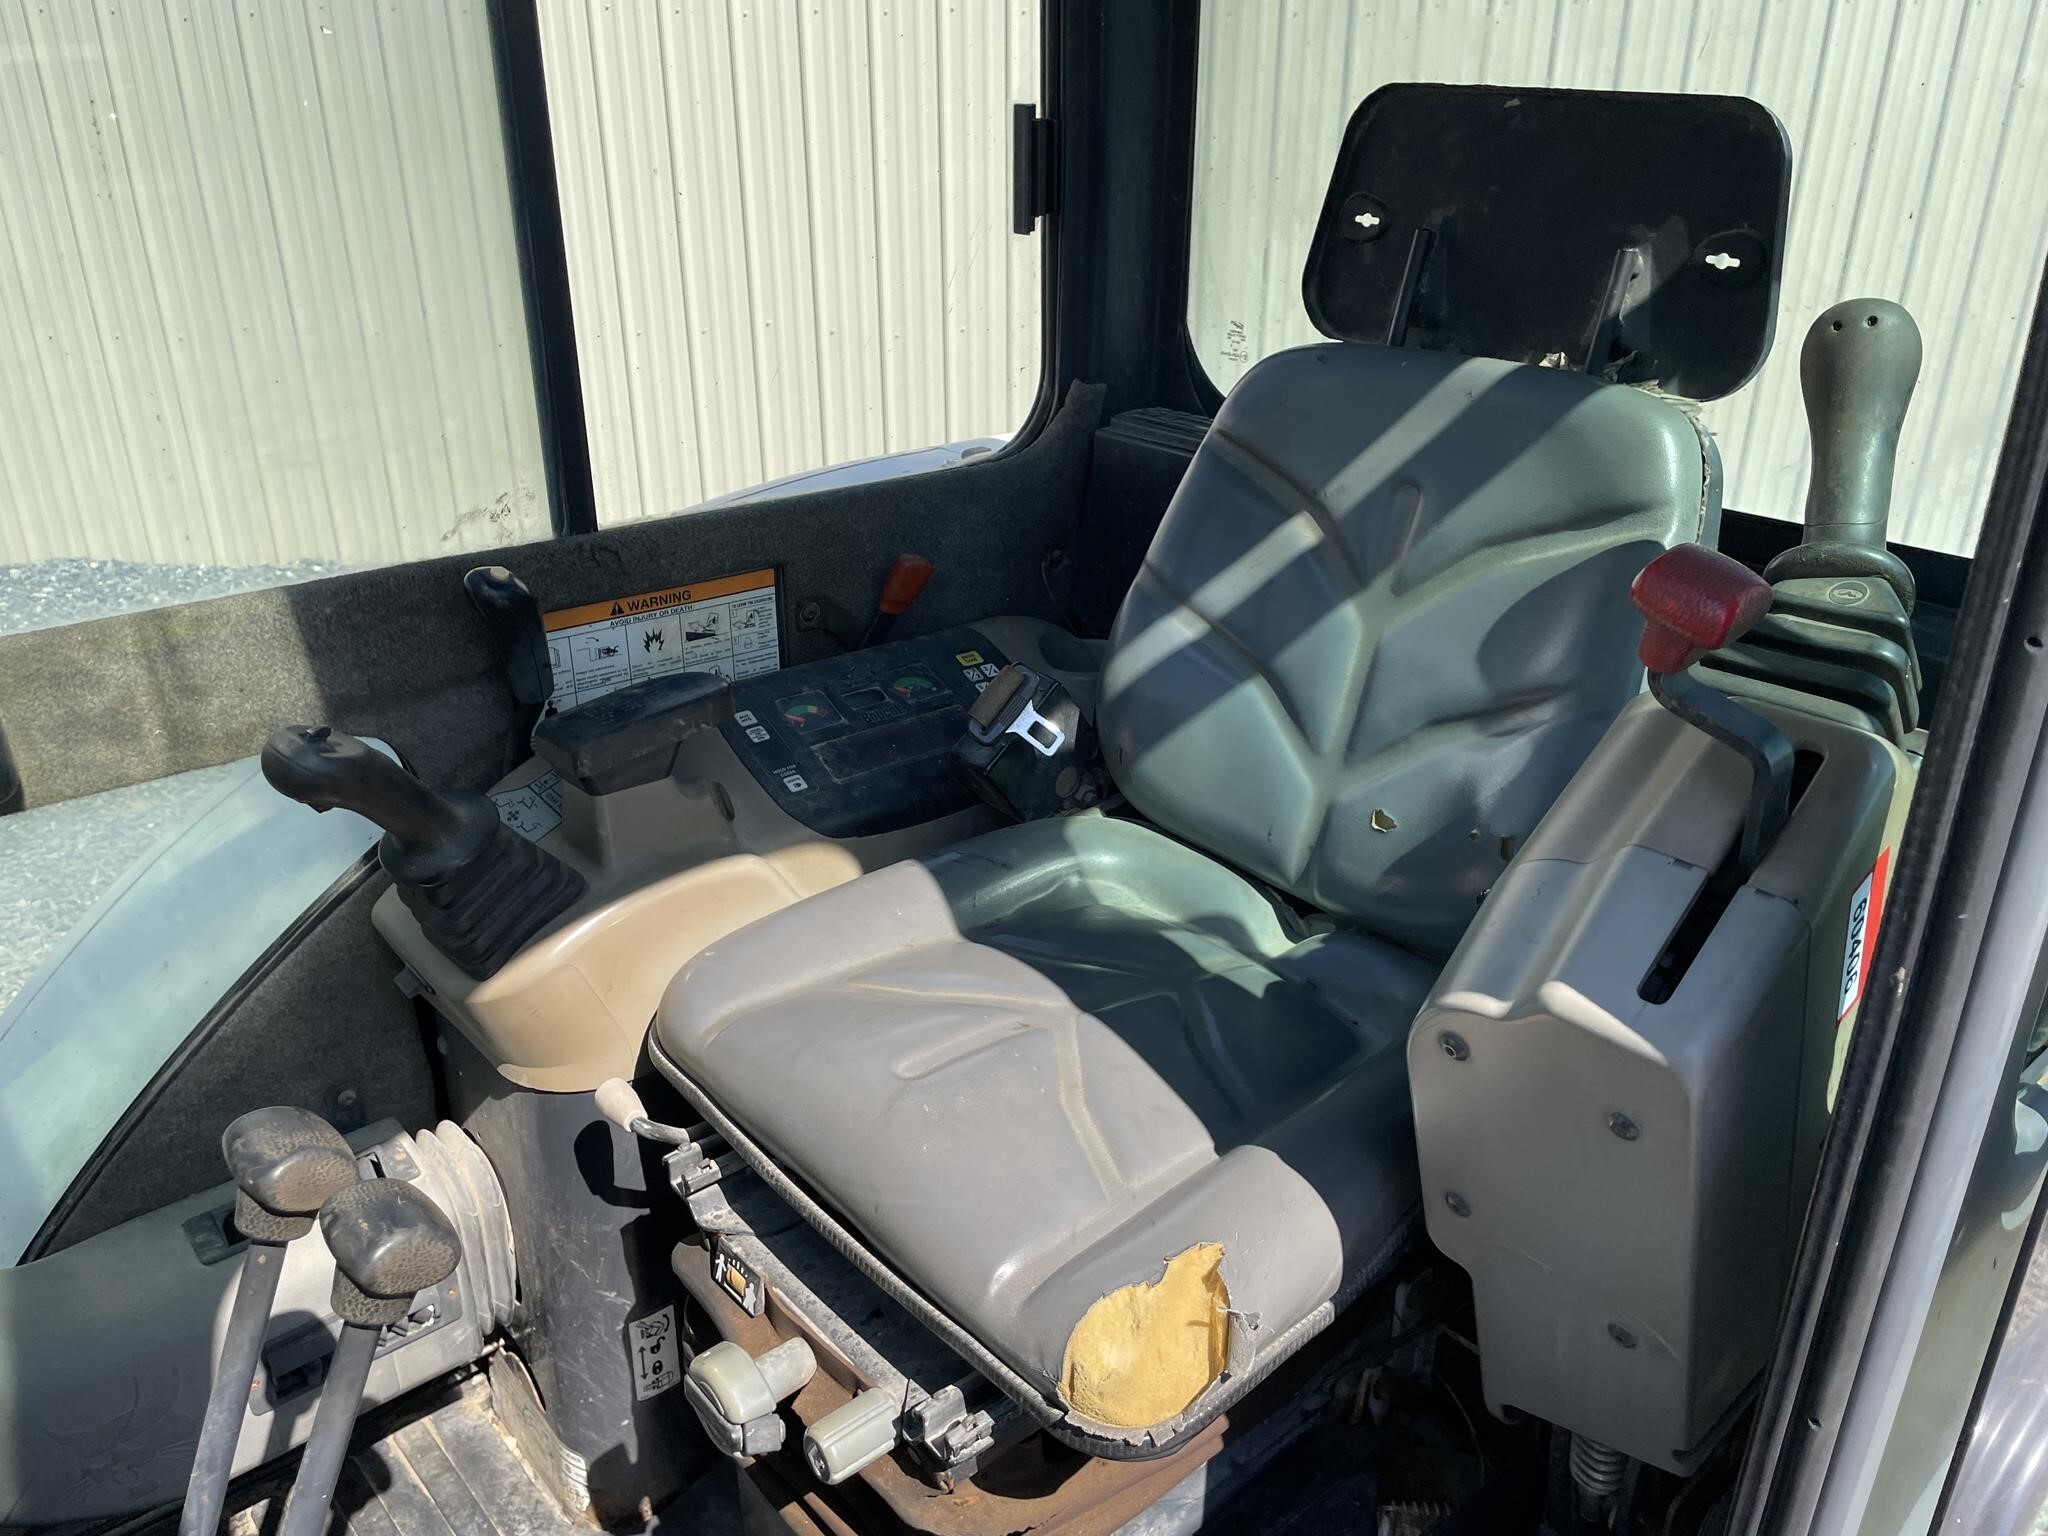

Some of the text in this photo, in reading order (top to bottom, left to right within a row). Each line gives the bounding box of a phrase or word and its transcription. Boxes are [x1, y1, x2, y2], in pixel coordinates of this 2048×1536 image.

[627, 590, 692, 612] WARNING
[610, 604, 693, 628] AVOID INJURY OR DEATH
[862, 705, 904, 723] Bobcat
[1844, 897, 1868, 995] 60406
